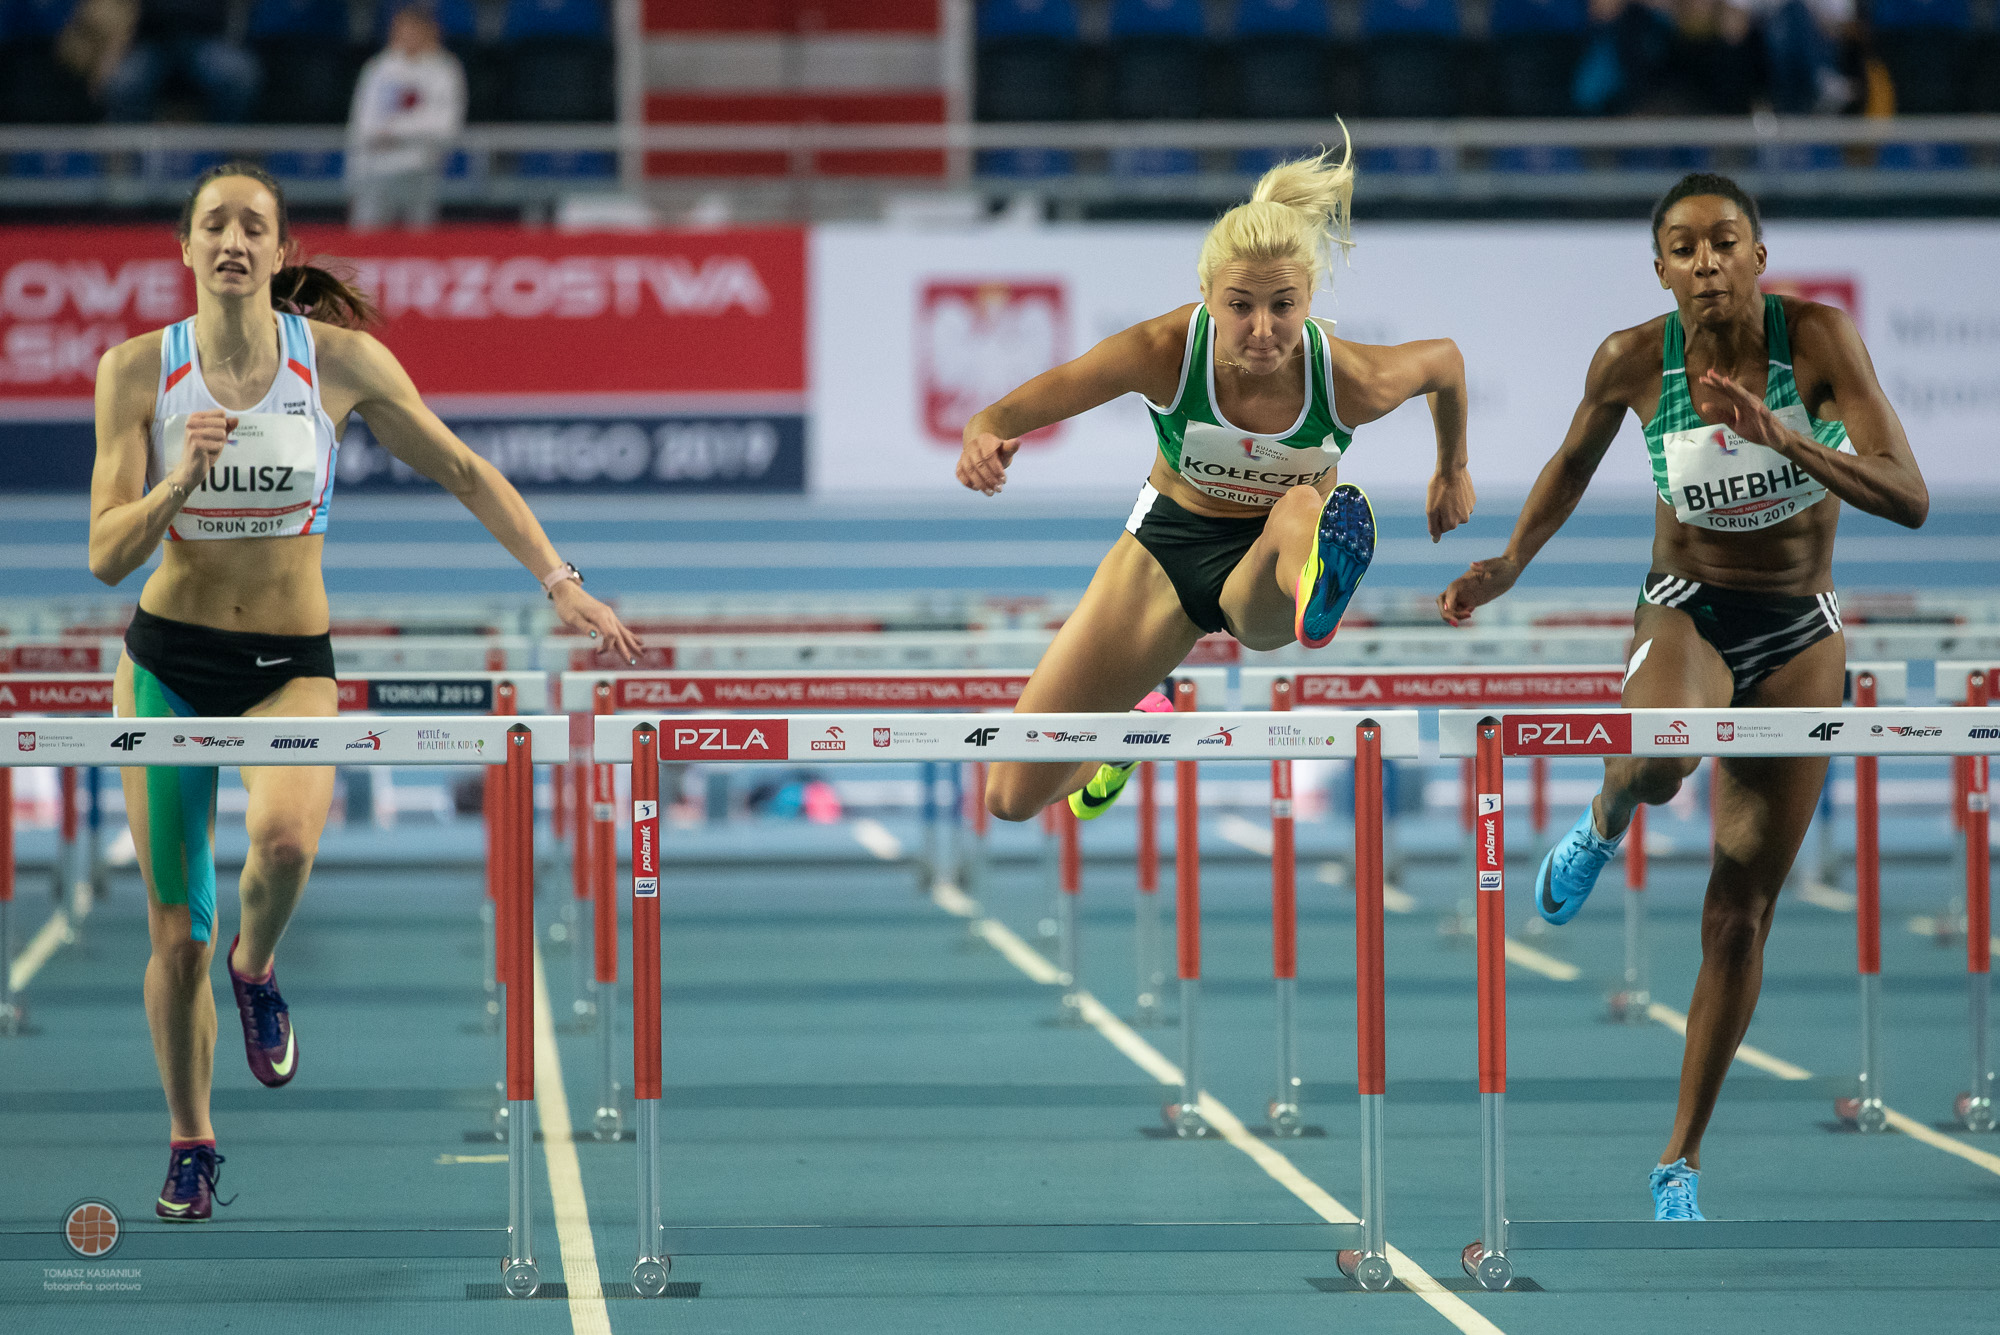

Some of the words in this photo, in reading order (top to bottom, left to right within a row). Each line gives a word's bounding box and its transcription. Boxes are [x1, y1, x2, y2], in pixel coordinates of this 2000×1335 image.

[0, 258, 180, 318] OWE
[1255, 444, 1283, 456] KUJAWY
[200, 466, 294, 492] ULISZ
[1206, 486, 1260, 504] TORUŃ
[1707, 510, 1759, 528] TORUŃ
[1763, 502, 1796, 524] 2019
[197, 517, 246, 533] TORUŃ
[250, 519, 284, 533] 2019
[624, 682, 704, 703] PZLA
[714, 683, 804, 701] HALOWE
[1303, 677, 1383, 699] PZLA
[1484, 677, 1622, 696] MISTRZOSTW
[417, 729, 441, 740] NESTLÉ
[441, 731, 450, 740] for
[674, 727, 770, 750] PZLA
[964, 727, 1000, 746] 4F
[1122, 733, 1171, 744] 4MOVE
[1268, 725, 1292, 736] NESTLÉ
[1292, 727, 1302, 735] for
[1518, 722, 1613, 745] PZLA
[1808, 722, 1845, 741] 4F
[1967, 728, 2000, 739] 4MO
[110, 732, 147, 751] 4F
[270, 738, 319, 750] 4MOVE
[345, 741, 374, 751] polanik
[417, 740, 456, 750] HEALTHIER
[457, 740, 474, 750] KIDS
[812, 741, 844, 750] ORLEN
[1196, 736, 1225, 746] polanik
[1268, 736, 1306, 746] HEALTHIER
[1308, 736, 1325, 746] KIDS
[1656, 736, 1688, 744] ORLEN
[640, 825, 653, 872] polanik
[1484, 819, 1498, 866] polanik
